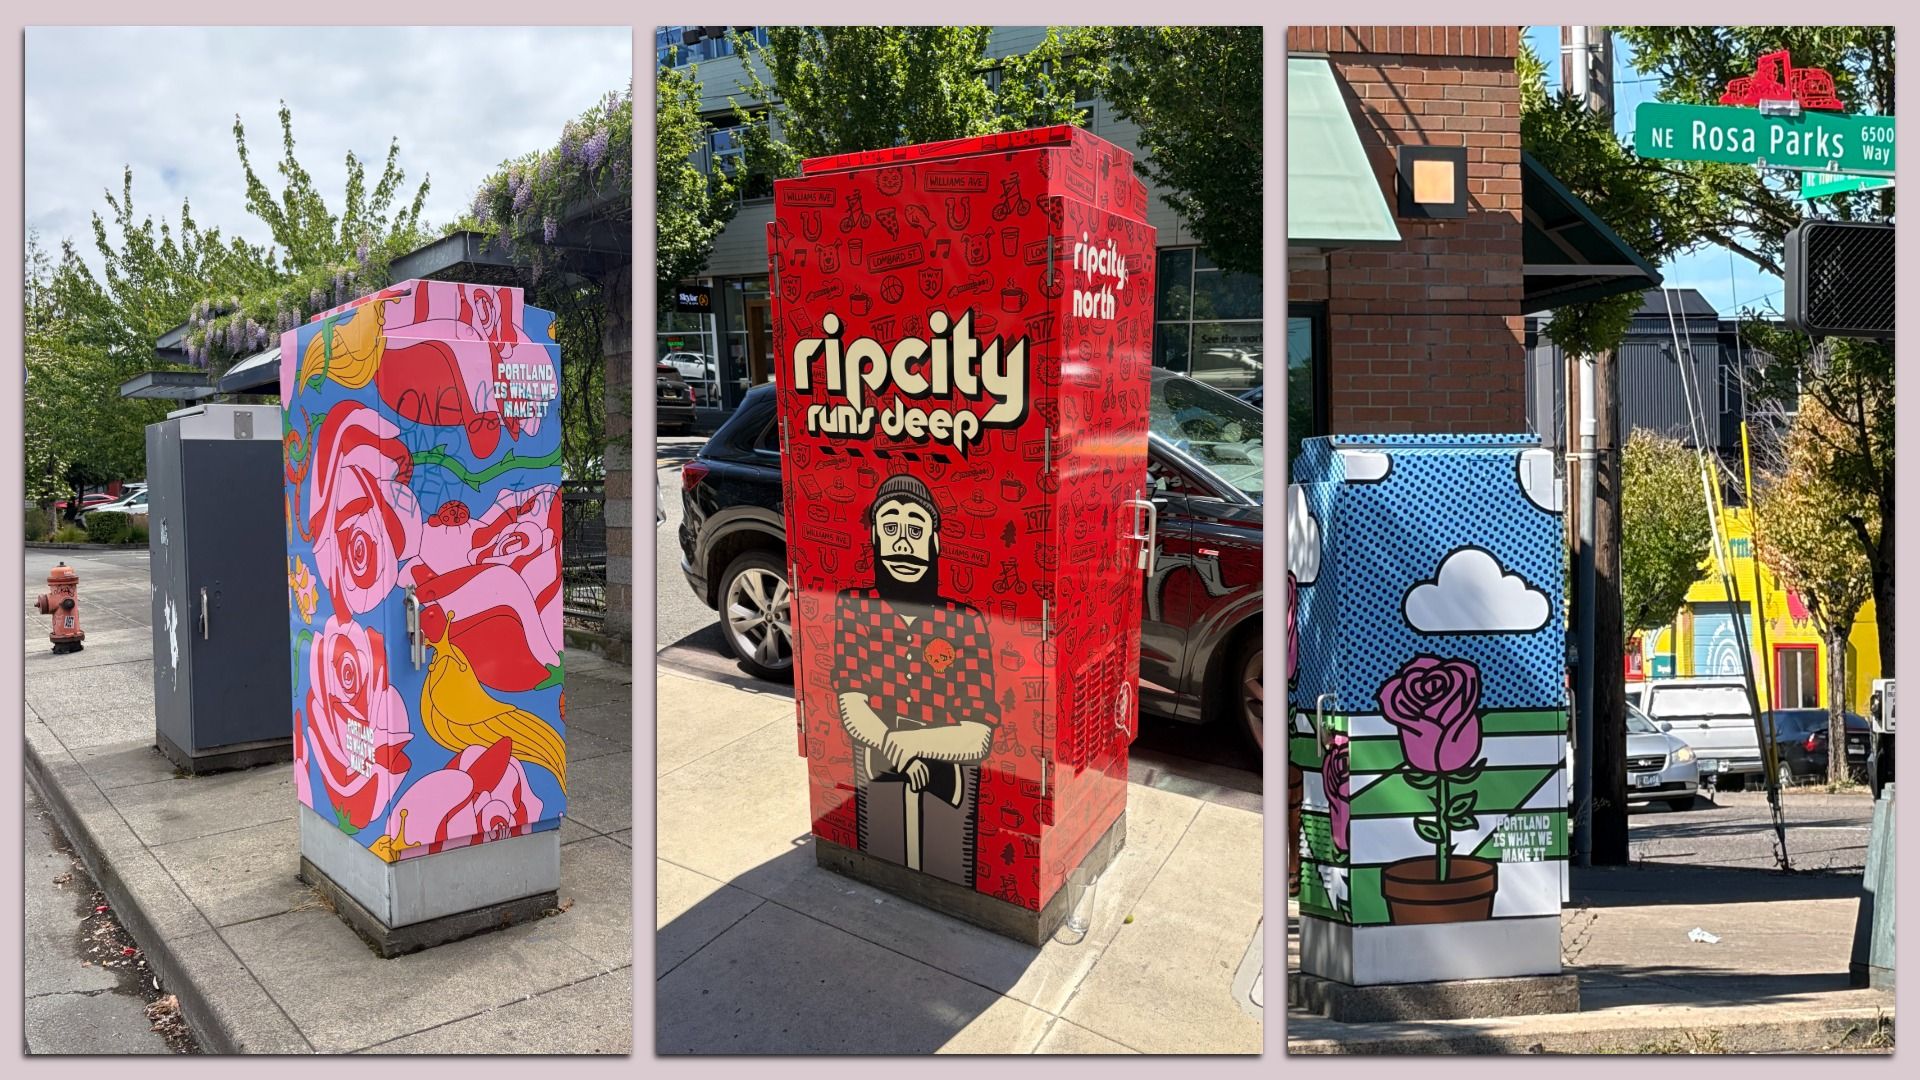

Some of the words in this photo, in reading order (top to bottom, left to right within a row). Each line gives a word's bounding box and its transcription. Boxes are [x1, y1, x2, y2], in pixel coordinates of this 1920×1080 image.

[1652, 127, 1674, 149] NE
[1692, 120, 1756, 153] Rosa
[1770, 125, 1845, 158] Parks
[1861, 126, 1895, 143] 6500
[1862, 144, 1890, 165] Way
[929, 176, 967, 187] WILLIAMS
[968, 176, 984, 187] AVE
[787, 192, 817, 203] WILLIAMS
[818, 192, 832, 203] AVE
[872, 253, 907, 268] LOMBARD
[908, 250, 918, 262] ST
[1074, 231, 1125, 290] ripcity
[921, 272, 940, 280] HWY
[787, 286, 797, 297] 30
[927, 280, 937, 291] 30
[1073, 283, 1115, 320] north
[871, 320, 896, 341] 1977
[1025, 317, 1055, 339] 1977
[498, 363, 553, 381] PORTLAND
[793, 308, 1027, 426] ripcity
[494, 381, 507, 399] IS
[510, 382, 538, 399] WHAT
[541, 382, 556, 400] WE
[503, 400, 534, 418] MAKE
[536, 401, 549, 418] IT
[807, 404, 876, 436] runs
[880, 393, 980, 455] deep
[796, 453, 807, 464] 30
[929, 463, 941, 474] 30
[1024, 508, 1051, 530] 1977
[806, 526, 834, 541] WILLIAMS
[835, 534, 848, 545] AVE
[970, 553, 985, 563] AVE
[347, 717, 374, 745] PORTLAND
[353, 737, 367, 758] WHAT
[367, 744, 375, 764] WE
[350, 752, 366, 776] MAKE
[1497, 815, 1551, 831] PORTLAND
[1493, 833, 1506, 847] IS
[1508, 831, 1536, 847] WHAT
[1538, 831, 1553, 846] WE
[1502, 848, 1531, 863] MAKE
[1533, 847, 1546, 862] IT
